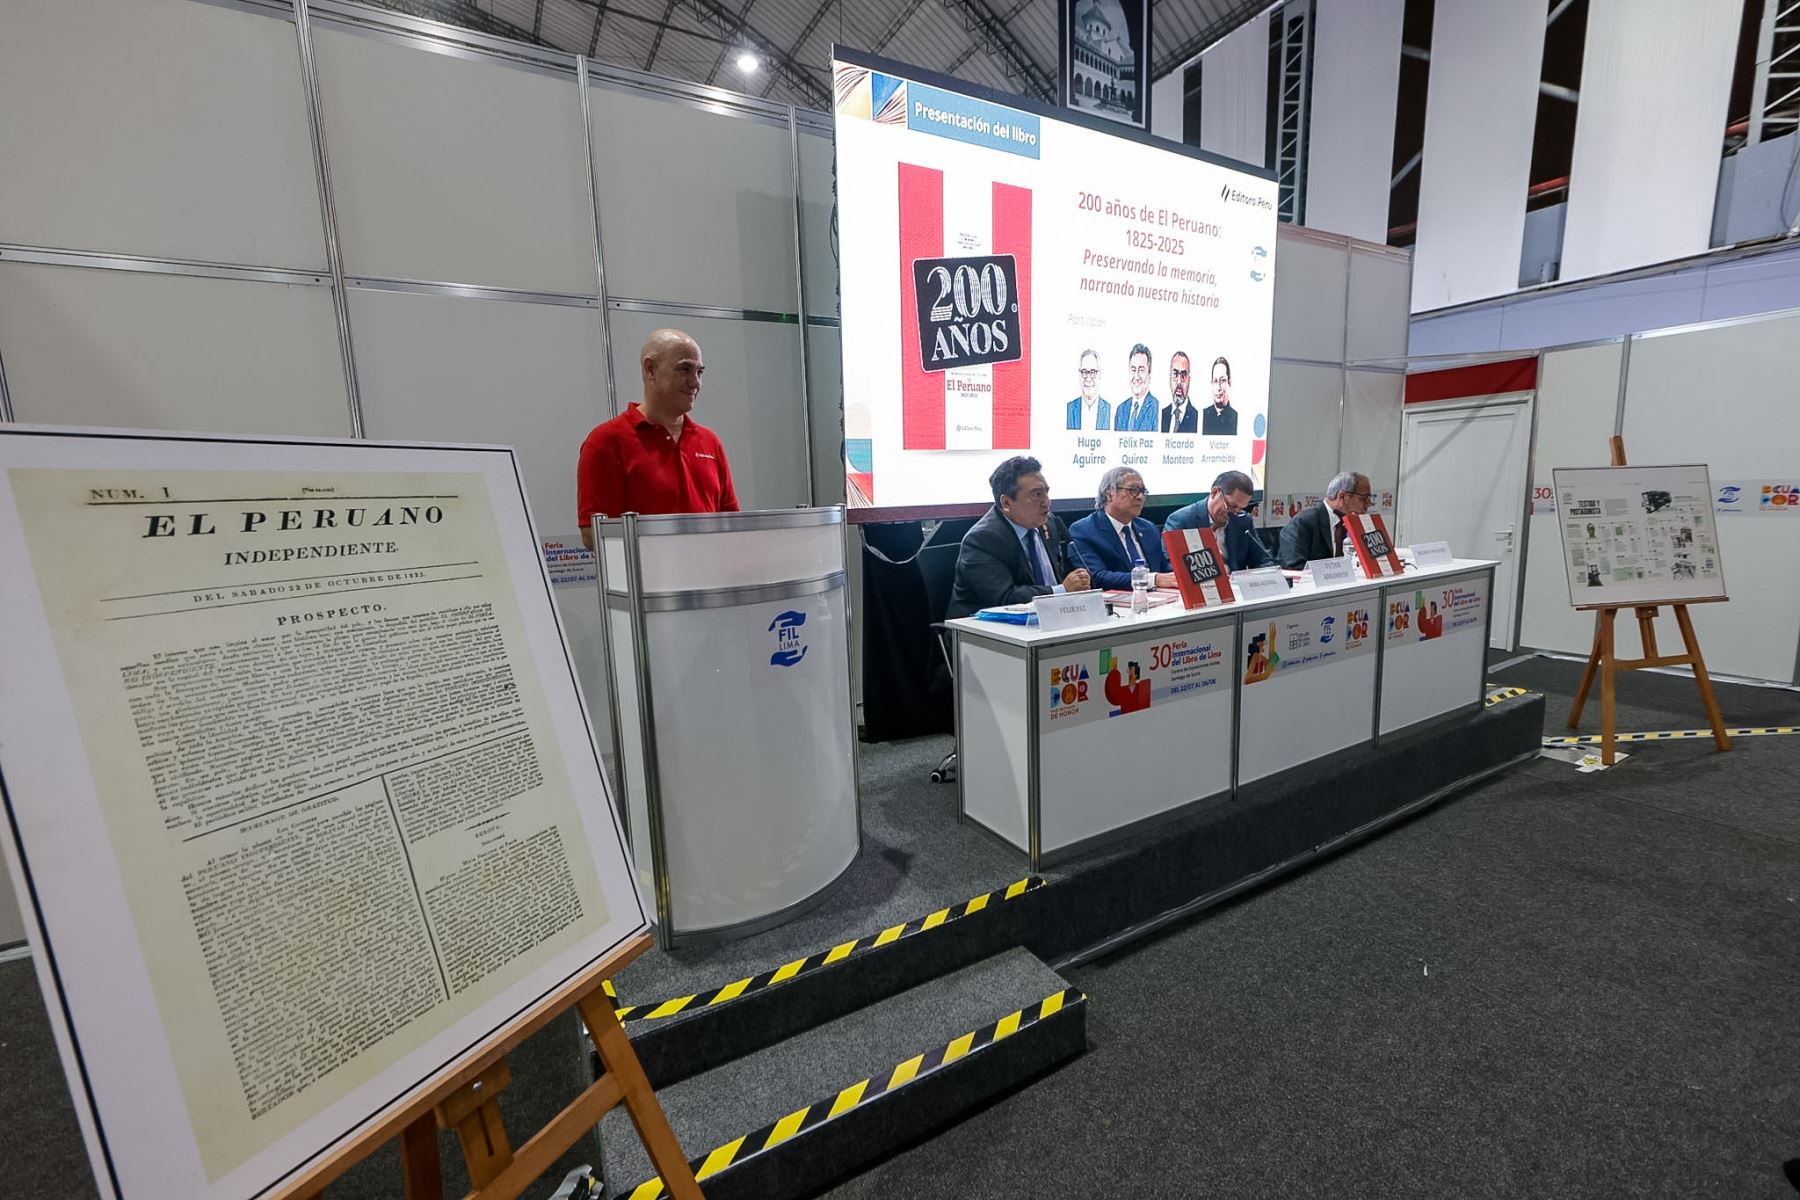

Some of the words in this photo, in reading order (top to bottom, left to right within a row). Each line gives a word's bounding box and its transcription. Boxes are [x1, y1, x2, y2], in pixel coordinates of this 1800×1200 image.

[914, 101, 990, 134] Presentación
[993, 122, 1009, 139] del
[1012, 125, 1037, 145] libro
[1078, 191, 1101, 212] 200
[1106, 199, 1136, 220] años
[1140, 205, 1154, 223] de
[1158, 209, 1168, 226] El
[1172, 213, 1222, 238] Peruano:
[1126, 229, 1185, 255] 1825-2025
[1083, 249, 1155, 275] Preservando
[1157, 261, 1167, 277] la
[1171, 267, 1217, 287] memoria,
[1080, 277, 1134, 296] narrando
[1137, 286, 1178, 303] nuestra
[1181, 289, 1219, 308] historia
[931, 317, 1008, 361] AÑOS
[947, 379, 955, 391] El
[957, 380, 991, 392] Peruano
[1077, 437, 1101, 451] Hugo
[1139, 438, 1153, 448] Paz
[1165, 439, 1194, 449] Ricardo
[1073, 453, 1105, 468] Aguirre
[1122, 454, 1148, 465] Quiroz
[1162, 454, 1194, 464] Montero
[89, 488, 145, 500] NUM.
[1534, 488, 1551, 499] 30
[142, 513, 216, 538] EL
[240, 505, 445, 533] PERUANO
[544, 541, 564, 549] Feria
[224, 541, 399, 566] INDEPENDIENTE.
[1186, 550, 1213, 571] 200
[193, 592, 226, 603] DEL
[231, 585, 286, 598] SABADO
[289, 584, 301, 592] 22
[305, 582, 322, 590] DE
[327, 575, 384, 587] OCTUBRE
[1441, 589, 1454, 609] 30
[277, 604, 387, 627] PROSPECTO.
[1346, 608, 1369, 624] ECUA
[779, 627, 799, 641] FIL
[779, 640, 800, 650] LIMA
[1172, 641, 1187, 650] Feria
[1149, 644, 1171, 671] 30
[1172, 658, 1181, 667] del
[1182, 656, 1198, 664] Libro
[1208, 651, 1222, 659] Lima
[1051, 664, 1089, 686] ECUA
